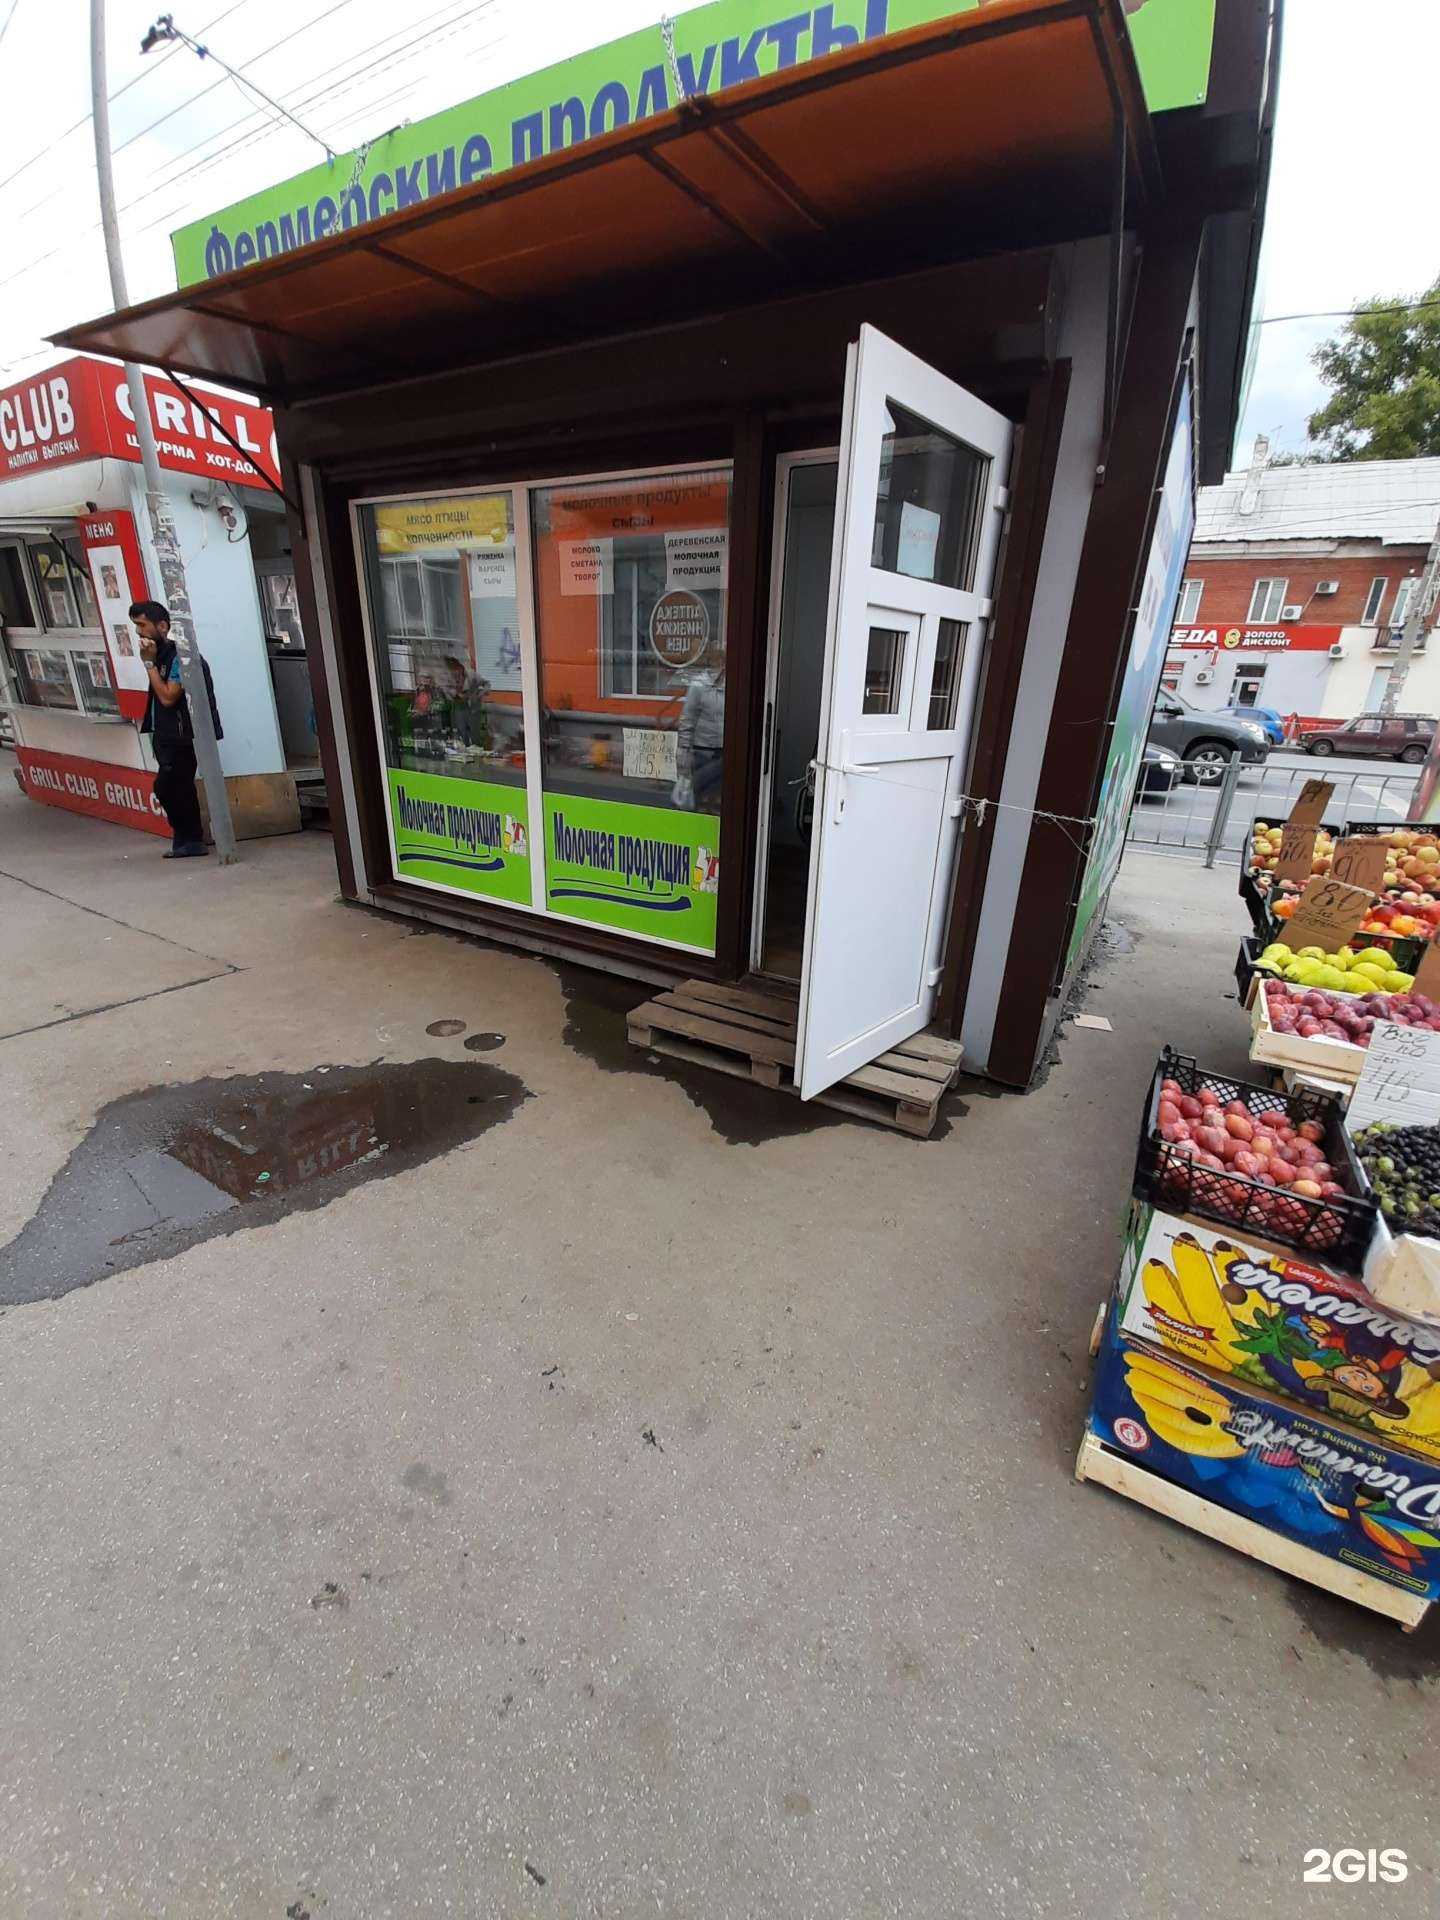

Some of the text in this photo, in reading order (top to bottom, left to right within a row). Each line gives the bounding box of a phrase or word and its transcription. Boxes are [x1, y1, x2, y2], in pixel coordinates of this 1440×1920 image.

[0, 377, 74, 451] CLUB
[42, 438, 80, 459] ВЫПЕЧКА
[125, 433, 196, 461] ШУРМА
[206, 452, 258, 475] ХОТ-ДО
[85, 522, 114, 539] МЕНЮ
[668, 535, 726, 548] ДЕРЕВЕНСКАЯ
[674, 551, 719, 561] МОЛОЧНАЯ
[672, 565, 721, 576] ПРОДУКЦИЯ
[1171, 629, 1218, 643] ЕДА
[1242, 639, 1292, 647] ДИСКОНТ
[29, 765, 66, 792] GRILL
[65, 773, 99, 800] CLUB
[105, 782, 148, 813] GRILL
[397, 786, 501, 855] Молочная продукция
[553, 812, 690, 891] Молочная продукция
